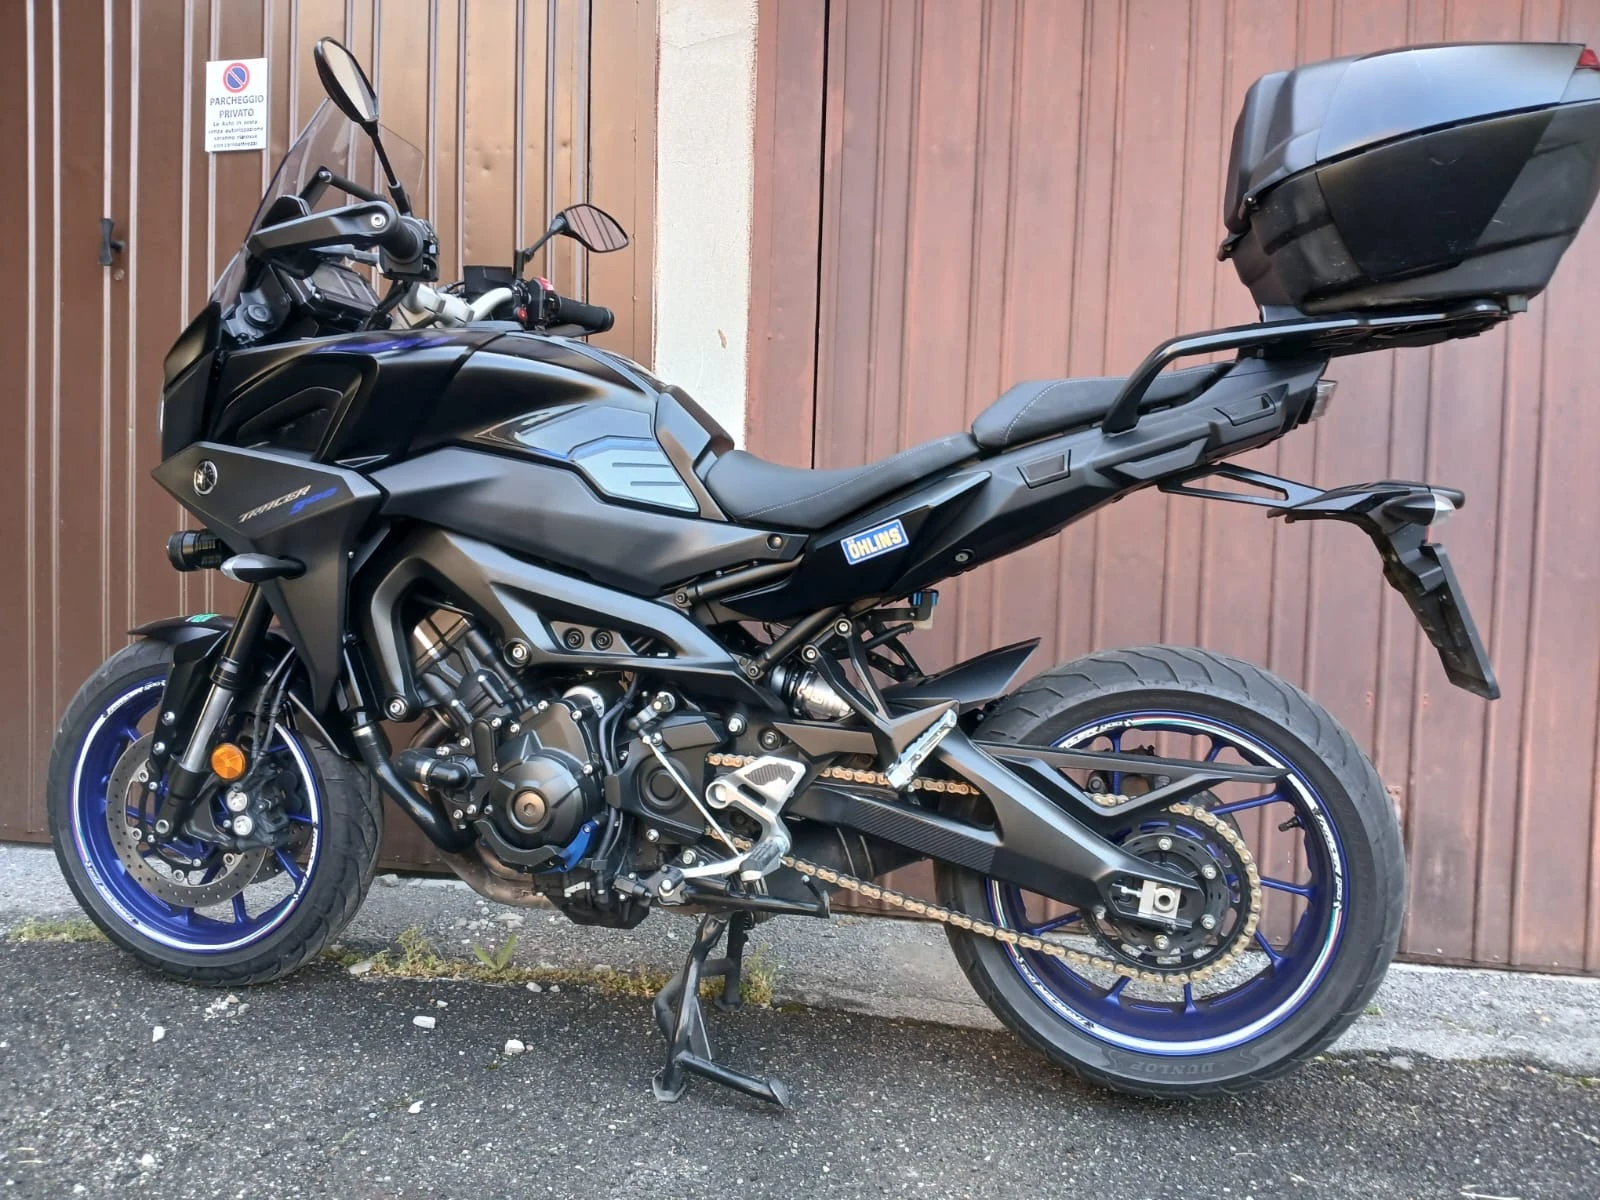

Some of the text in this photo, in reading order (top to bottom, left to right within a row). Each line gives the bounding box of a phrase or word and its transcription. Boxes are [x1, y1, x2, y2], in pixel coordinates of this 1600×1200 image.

[209, 95, 264, 105] PARCHEGGIO
[219, 108, 254, 118] PRIVATO
[846, 527, 903, 560] ÖHLINS
[1129, 1061, 1215, 1076] DUNLOP
